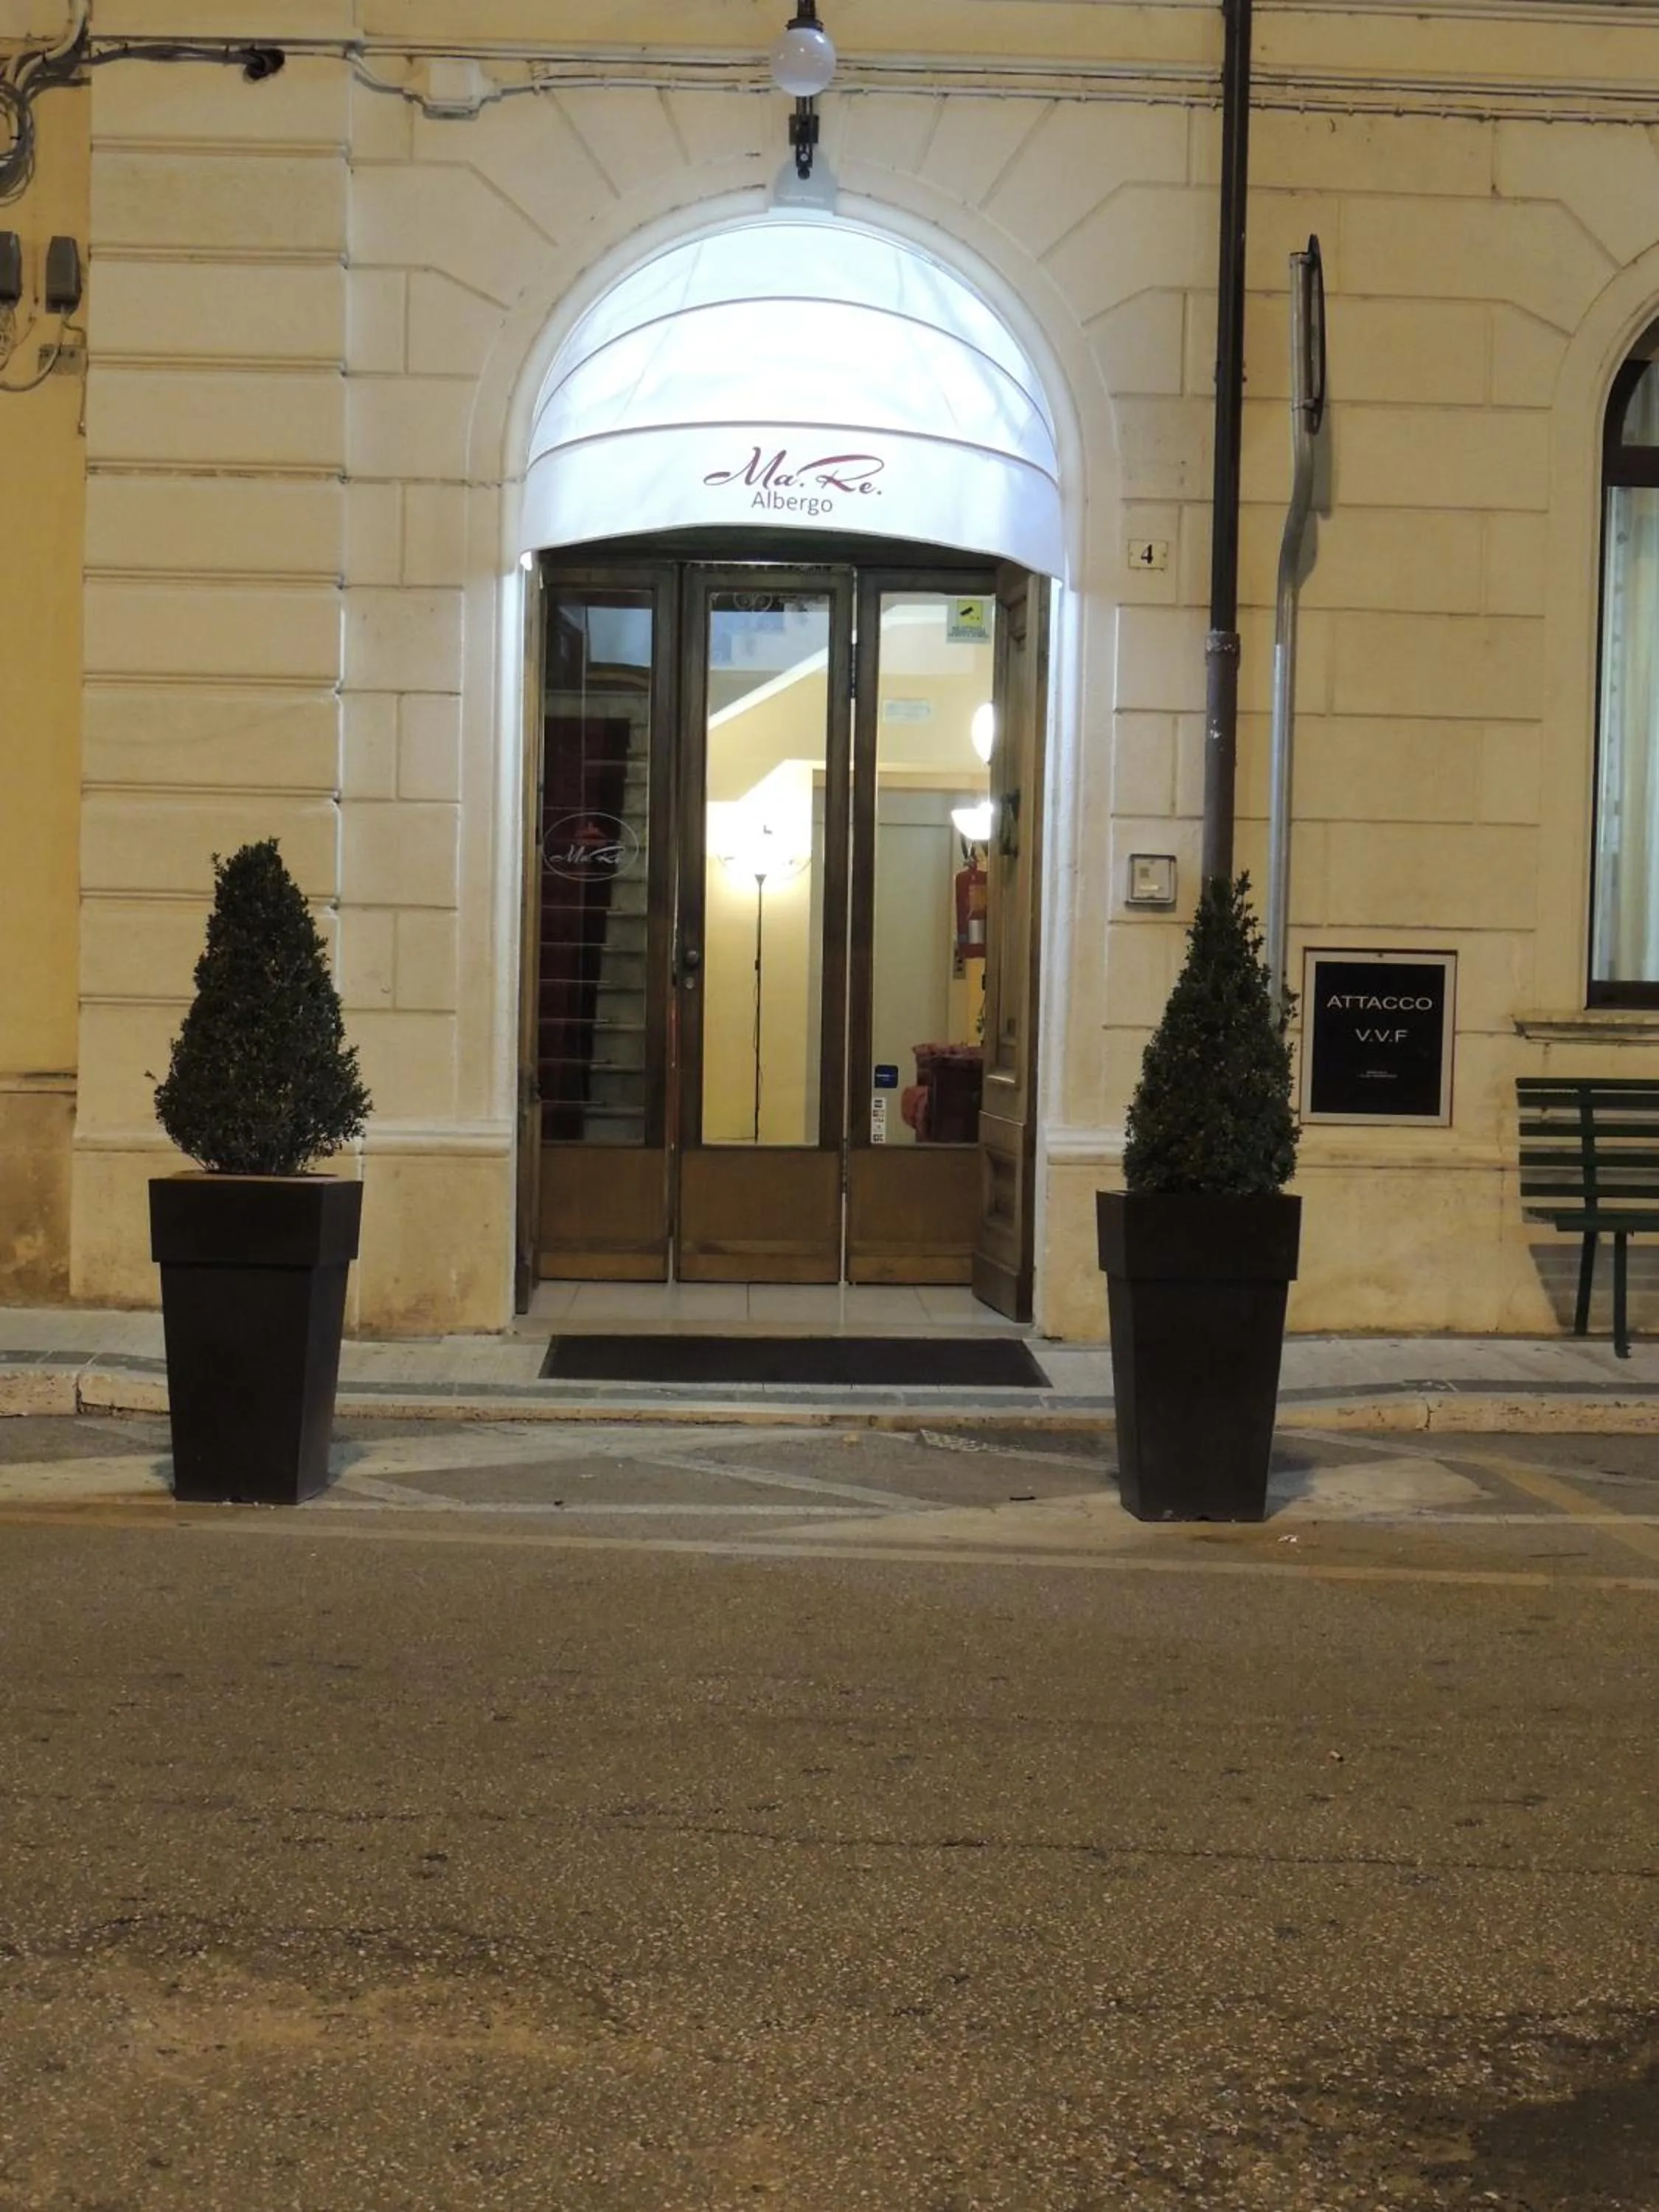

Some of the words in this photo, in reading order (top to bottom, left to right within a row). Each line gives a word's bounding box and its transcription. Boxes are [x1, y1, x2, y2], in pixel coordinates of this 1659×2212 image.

[751, 490, 833, 515] Albergo
[1141, 544, 1153, 564] 4
[1326, 995, 1433, 1010] ATTACCO
